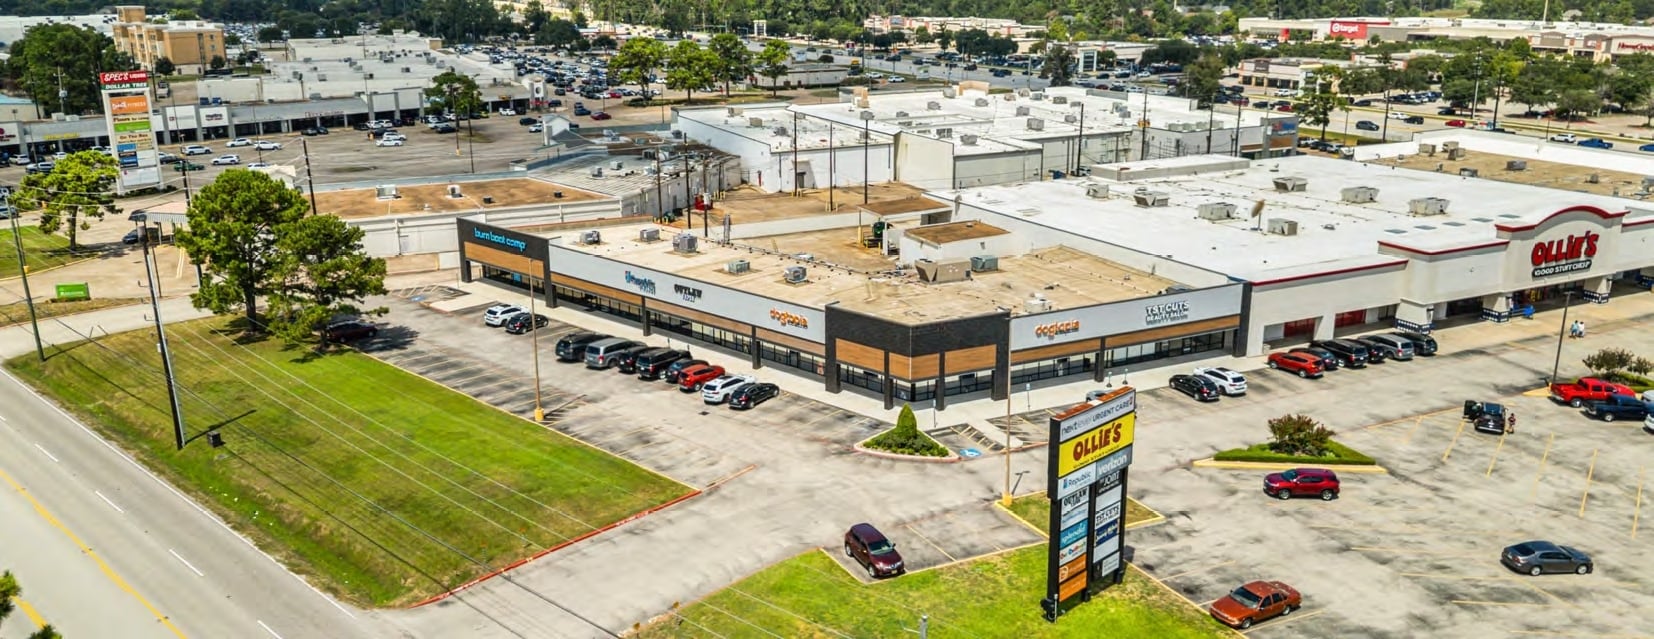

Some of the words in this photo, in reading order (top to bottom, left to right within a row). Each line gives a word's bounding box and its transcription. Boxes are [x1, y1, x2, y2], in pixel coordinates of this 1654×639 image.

[1340, 24, 1359, 33] target
[104, 72, 129, 81] SPEC'S
[474, 227, 490, 240] burn
[1531, 230, 1600, 267] OLLIE'S
[1164, 301, 1189, 312] CUTS
[770, 308, 808, 326] dogtopia
[1034, 320, 1080, 337] dogtopia
[1092, 406, 1115, 422] URGENT
[1115, 400, 1129, 412] CARE
[1073, 422, 1122, 461] OLLIE'S
[1098, 454, 1127, 475] verizon
[1063, 488, 1087, 507] OUTLAW
